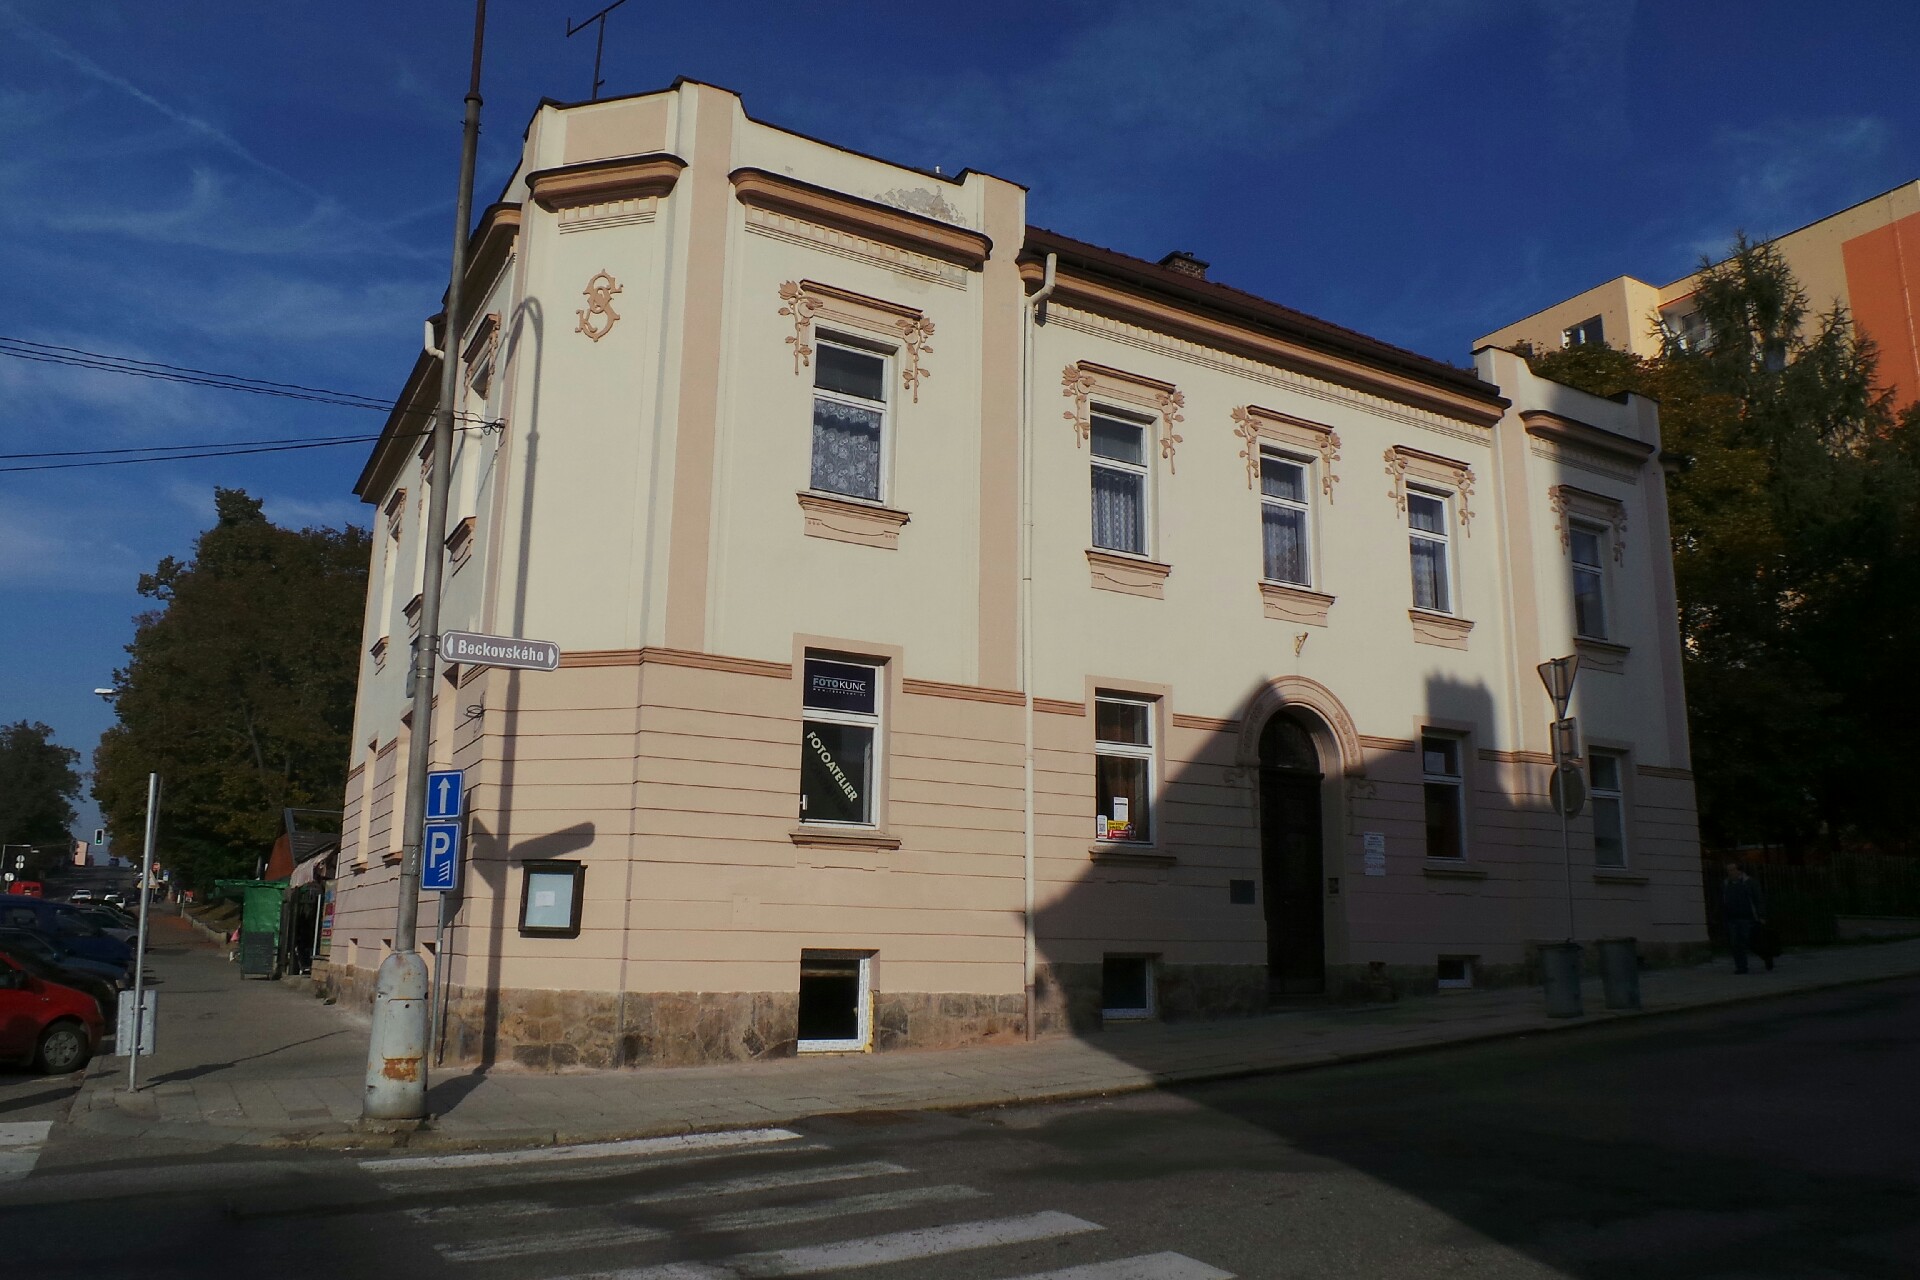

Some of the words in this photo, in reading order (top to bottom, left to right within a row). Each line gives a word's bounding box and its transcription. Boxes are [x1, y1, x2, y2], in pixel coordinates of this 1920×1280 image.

[458, 639, 544, 662] Beckovského
[813, 677, 866, 691] FOTOKUNC
[806, 731, 858, 802] FOTOATELIER
[430, 832, 450, 868] P
